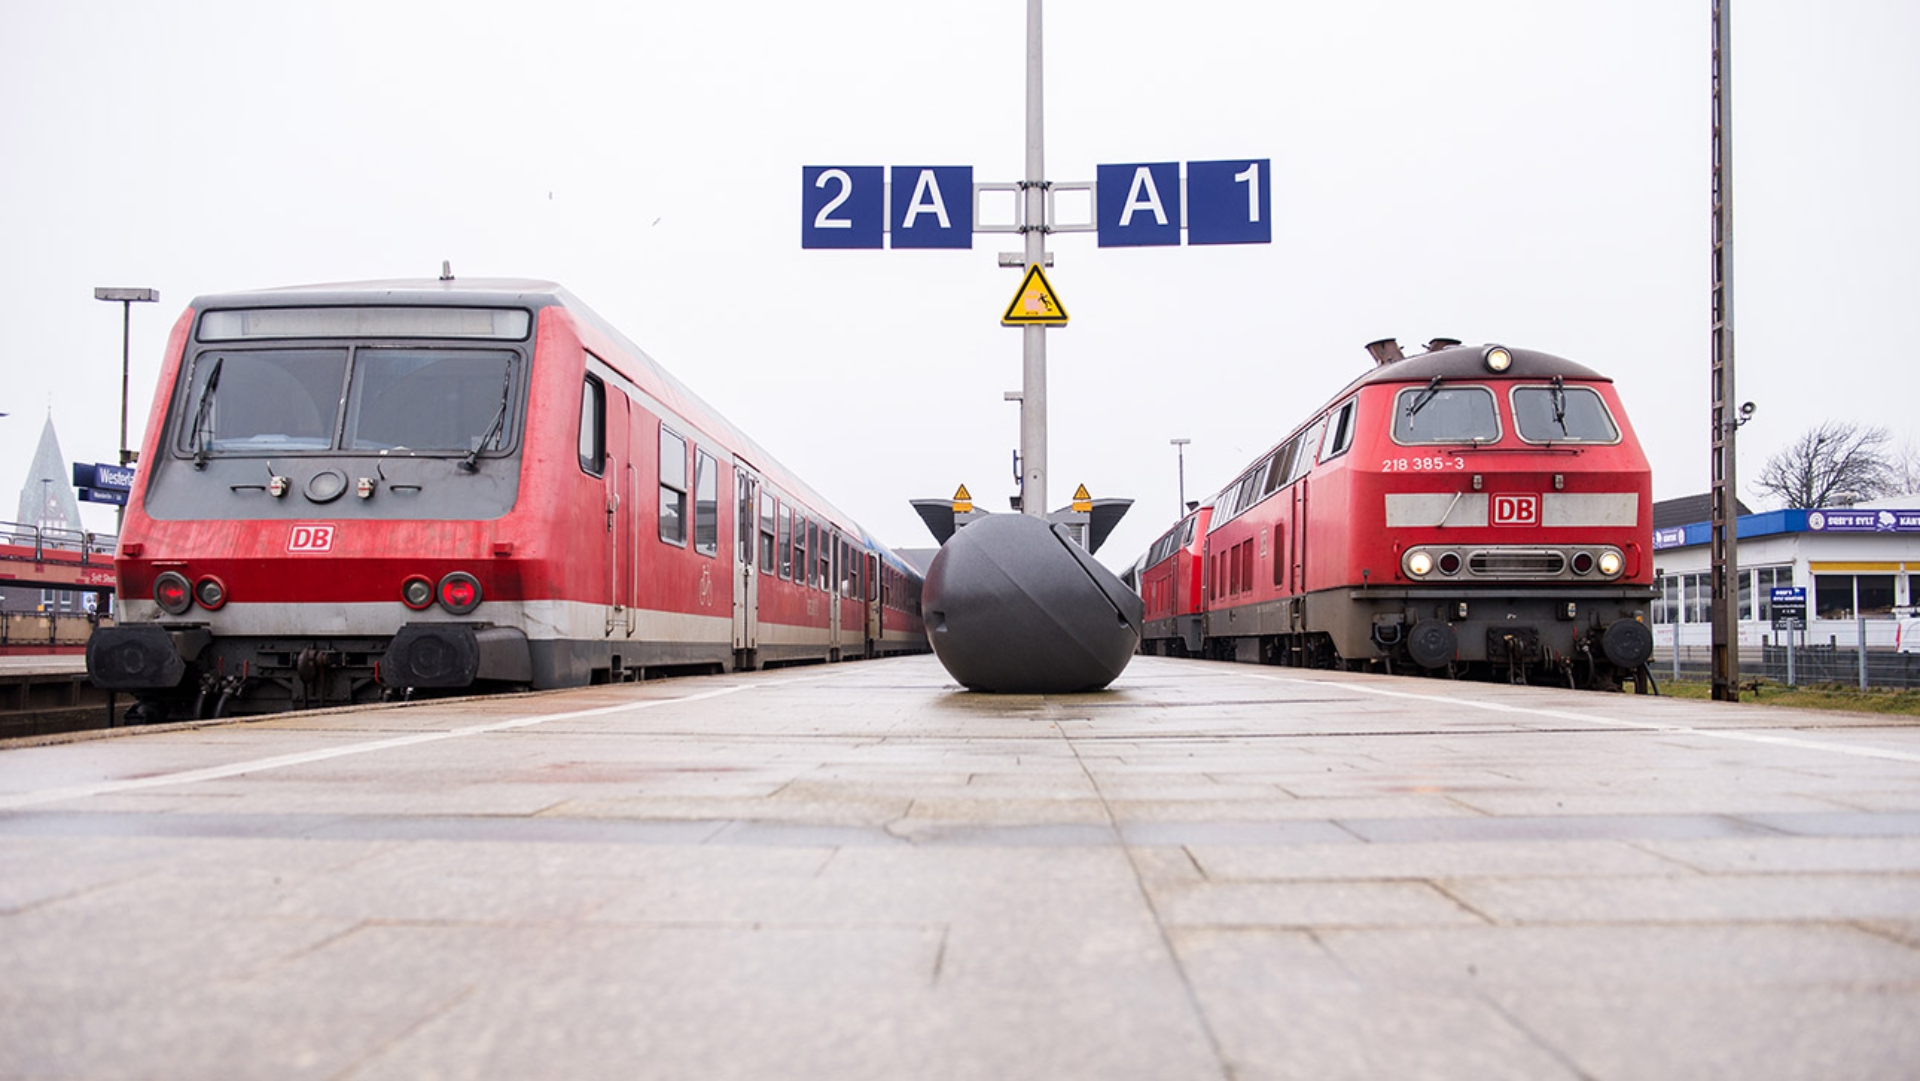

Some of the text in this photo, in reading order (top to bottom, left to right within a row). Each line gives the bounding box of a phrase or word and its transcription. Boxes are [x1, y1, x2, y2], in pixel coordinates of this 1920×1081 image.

[813, 169, 952, 229] 2 A
[1118, 163, 1260, 227] A 1
[1382, 456, 1464, 473] 218 385-3
[1497, 498, 1534, 521] DB
[291, 527, 331, 549] DB
